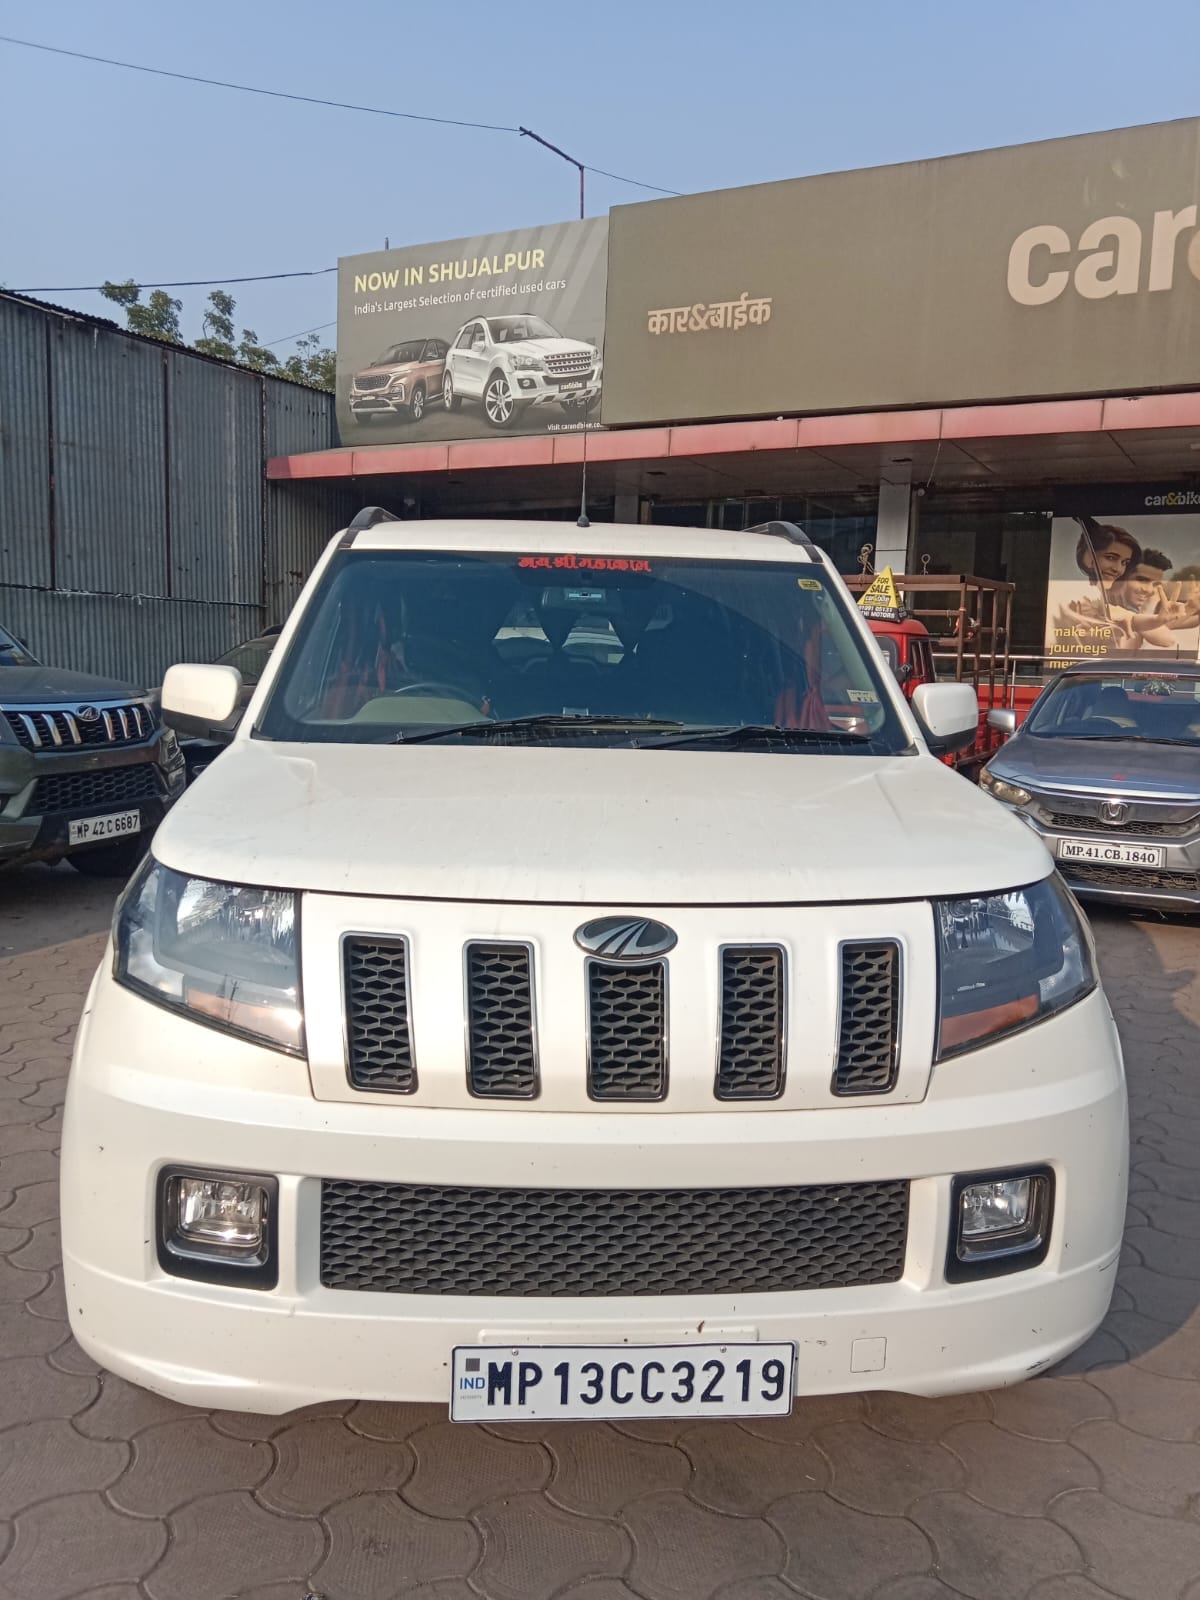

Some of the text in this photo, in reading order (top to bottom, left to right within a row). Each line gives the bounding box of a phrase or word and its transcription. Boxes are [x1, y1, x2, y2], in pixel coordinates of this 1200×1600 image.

[1007, 205, 1200, 306] car
[354, 249, 545, 293] NOW IN SHUJALPUR
[354, 280, 567, 315] India's Largest Selection of certified used cars
[870, 584, 891, 594] SALE
[876, 577, 890, 585] FOR
[1054, 626, 1111, 638] make the
[1049, 643, 1107, 656] journeys
[77, 823, 89, 838] MP
[93, 821, 105, 836] 42
[115, 815, 138, 831] 6687
[460, 1377, 486, 1390] IND
[487, 1359, 786, 1406] MP13CC3219
